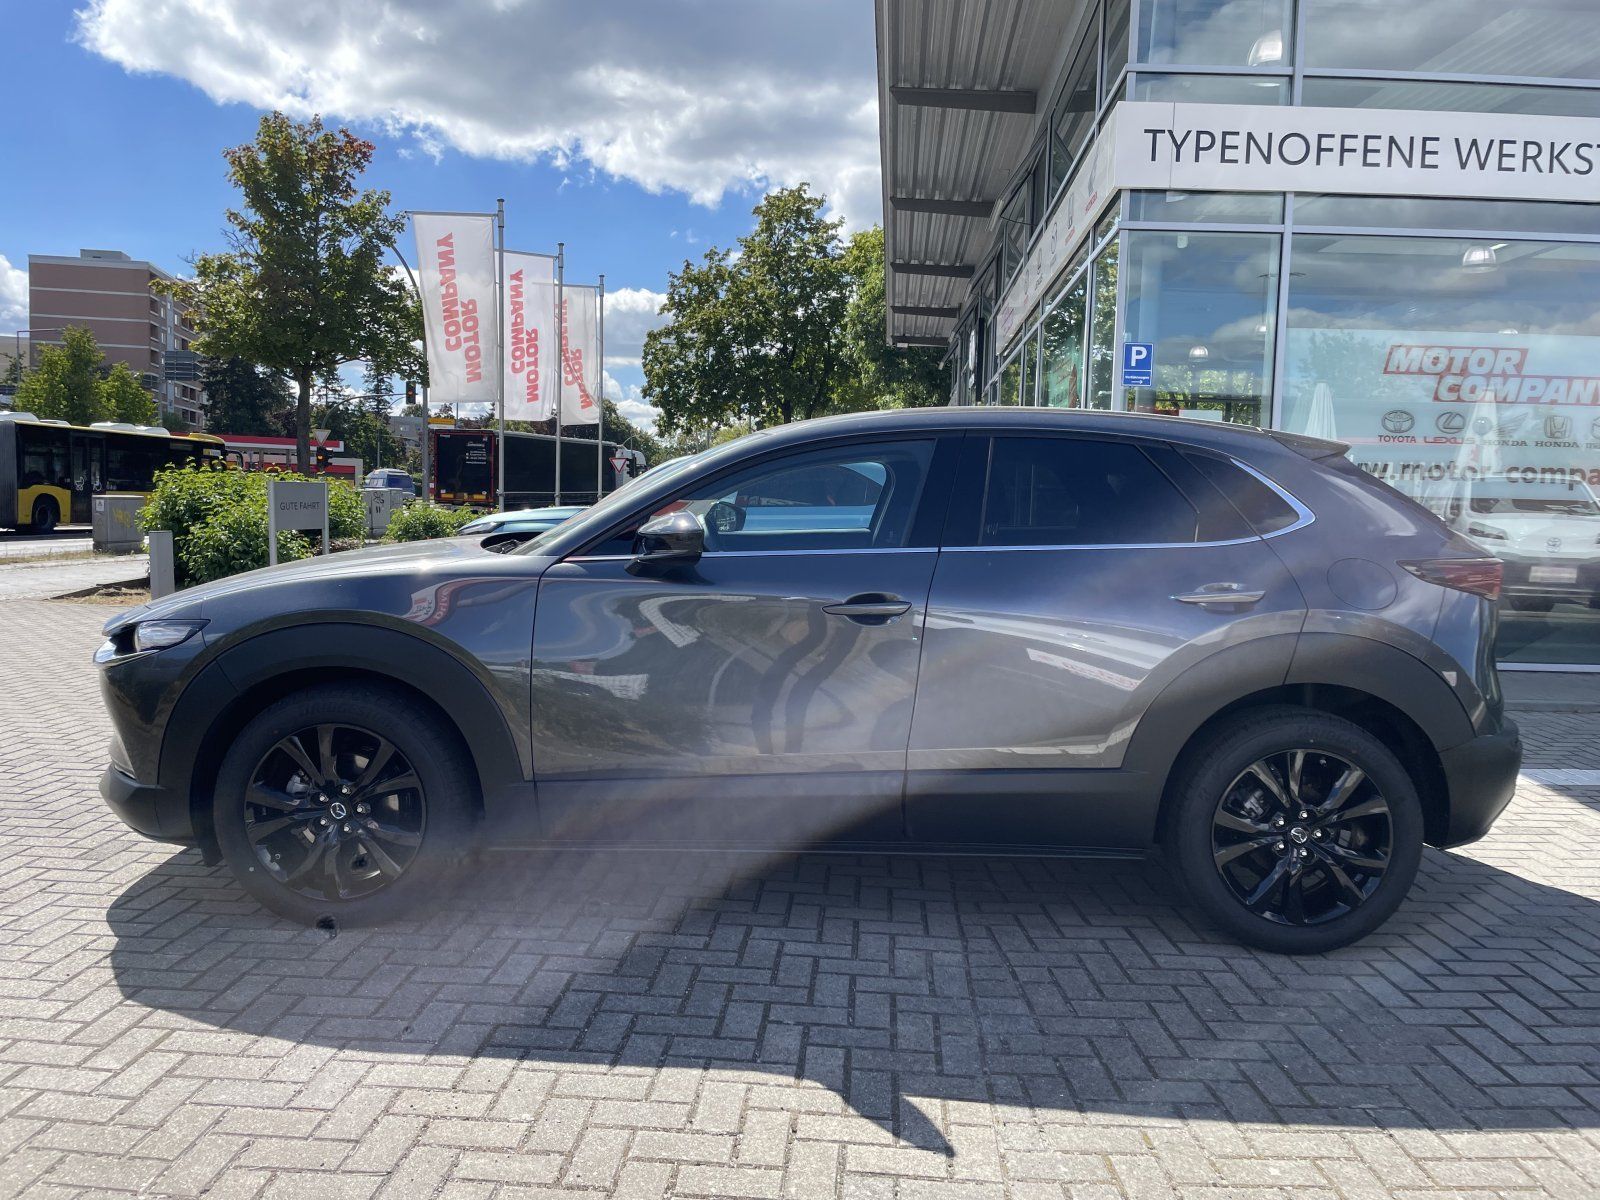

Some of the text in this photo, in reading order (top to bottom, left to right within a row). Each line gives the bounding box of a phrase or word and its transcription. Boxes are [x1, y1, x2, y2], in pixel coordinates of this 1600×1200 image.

[1143, 128, 1600, 176] TYPENOFFENE WERKS
[1131, 346, 1148, 367] P
[1387, 346, 1523, 375] MOTOR
[1436, 375, 1600, 405] COMPAN
[1378, 434, 1417, 444] TOYOTA
[1423, 436, 1476, 445] LEXUS
[1534, 441, 1580, 449] HONDA
[280, 501, 321, 511] GUTE FAHRT
